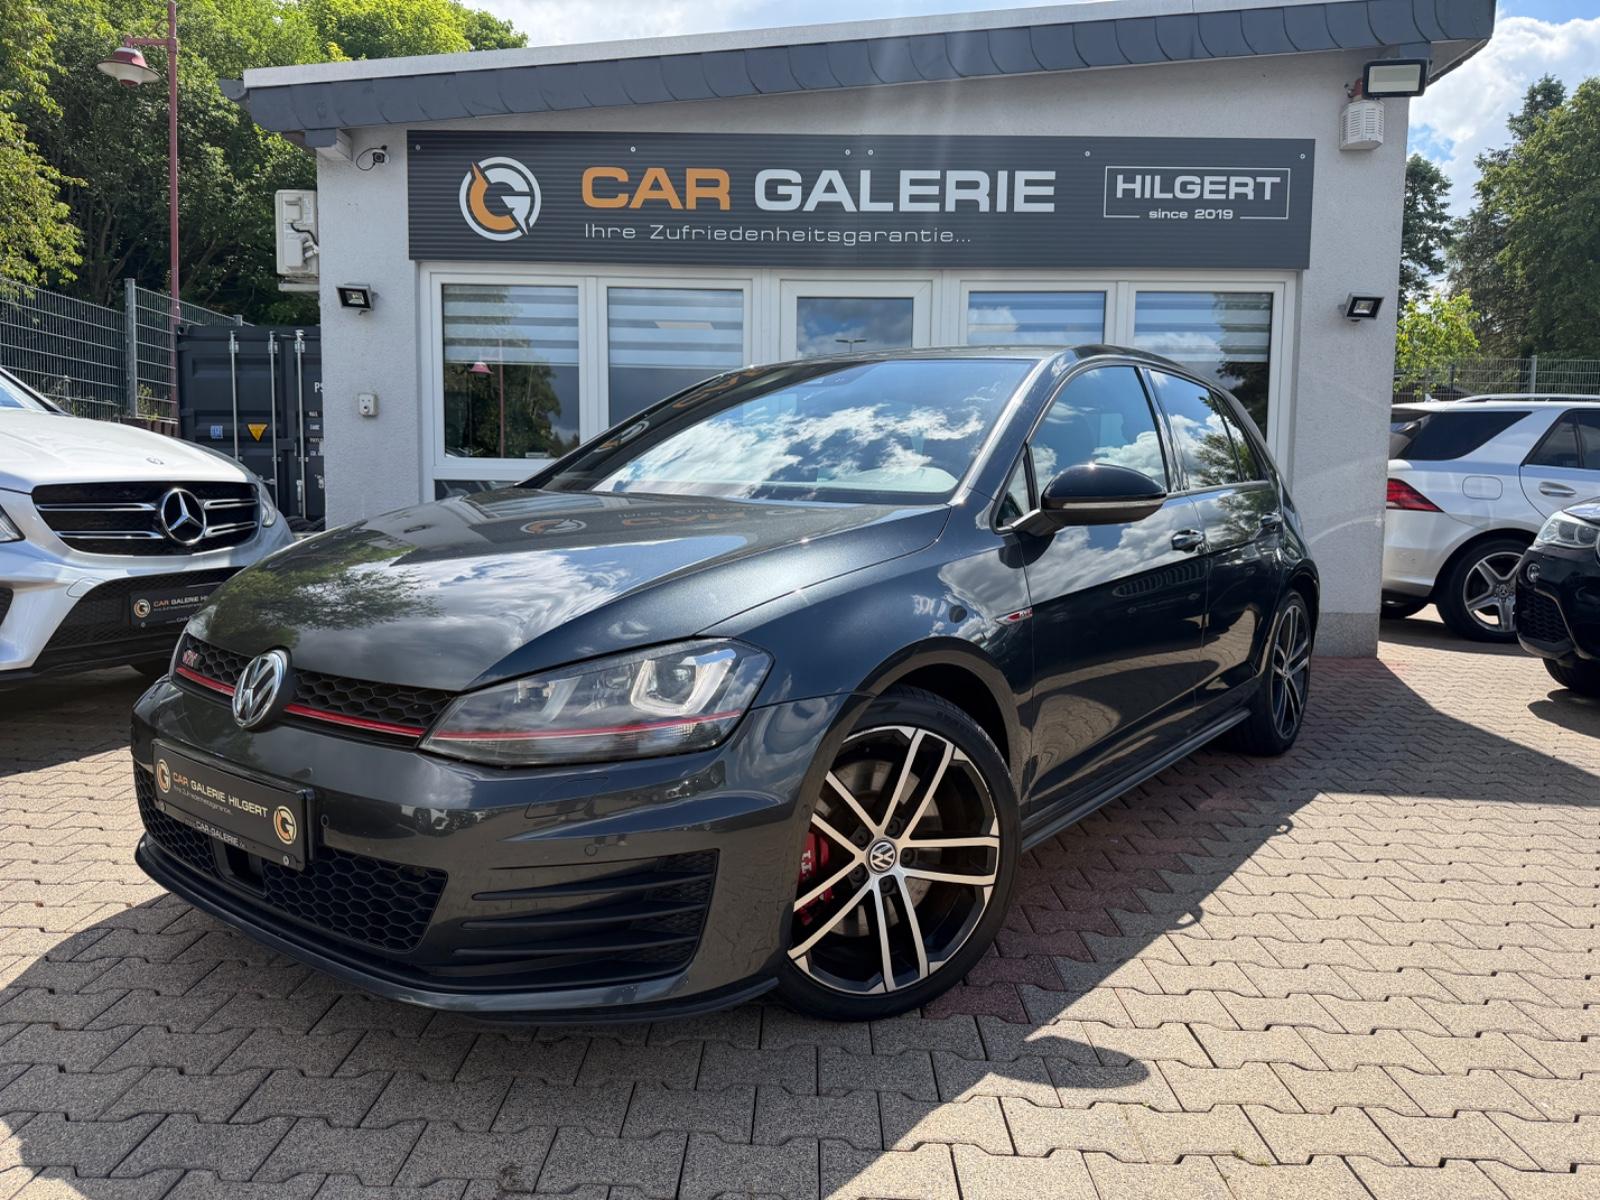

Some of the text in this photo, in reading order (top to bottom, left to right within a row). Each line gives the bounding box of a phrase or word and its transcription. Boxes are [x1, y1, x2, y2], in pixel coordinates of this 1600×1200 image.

[581, 166, 1056, 212] CAR GALERIE
[1116, 174, 1281, 200] HILGERT
[1148, 208, 1234, 220] since 2019
[585, 223, 971, 246] Ihre Zufriedenheitsgarantie...
[153, 600, 169, 608] CAR
[172, 771, 189, 786] CAR
[190, 779, 226, 803] GALERIE
[228, 794, 269, 818] HILGERT
